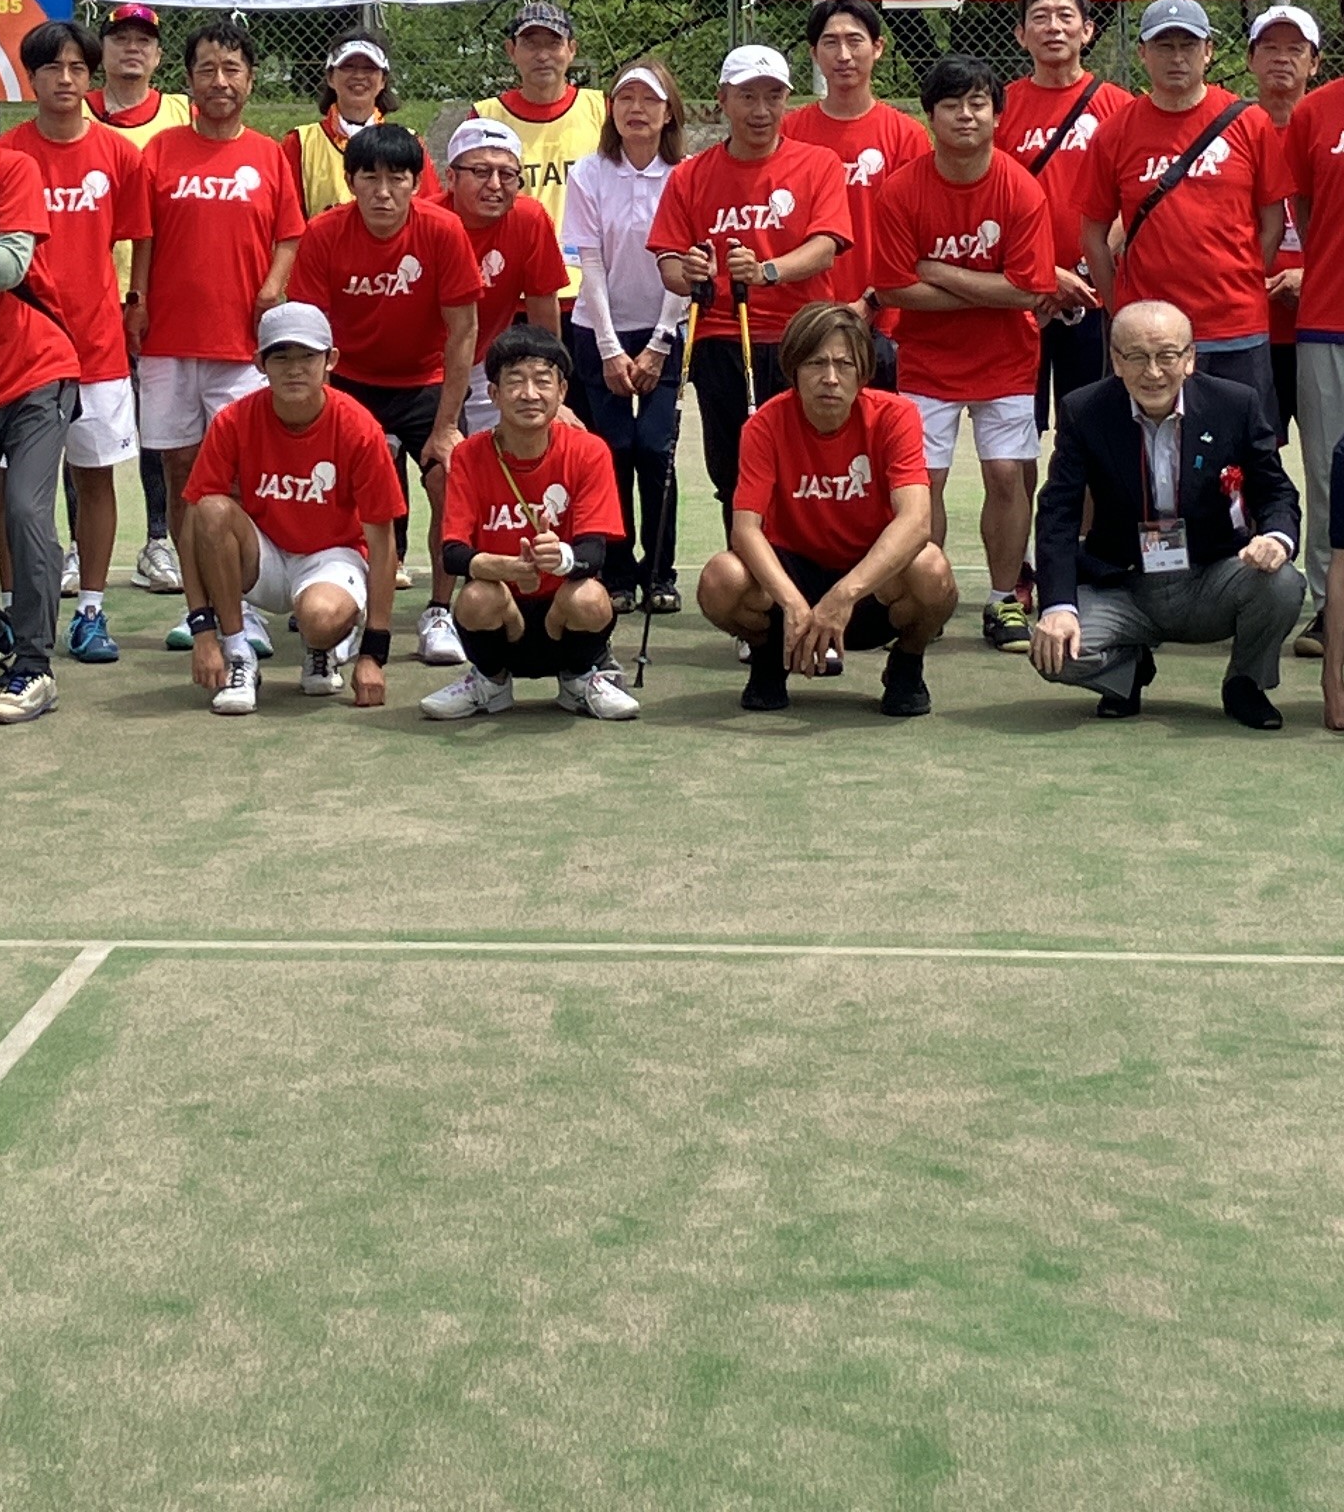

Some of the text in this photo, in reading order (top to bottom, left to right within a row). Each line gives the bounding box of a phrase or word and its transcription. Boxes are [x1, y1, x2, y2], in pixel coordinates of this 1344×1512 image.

[518, 161, 575, 189] TAF
[1139, 154, 1221, 182] JATA
[44, 188, 99, 212] STA
[170, 175, 251, 202] JASTA
[708, 205, 784, 235] JASTA
[927, 233, 992, 261] JASTA
[342, 274, 413, 297] JASTA
[255, 474, 328, 504] JASTA
[793, 474, 870, 500] JASTA
